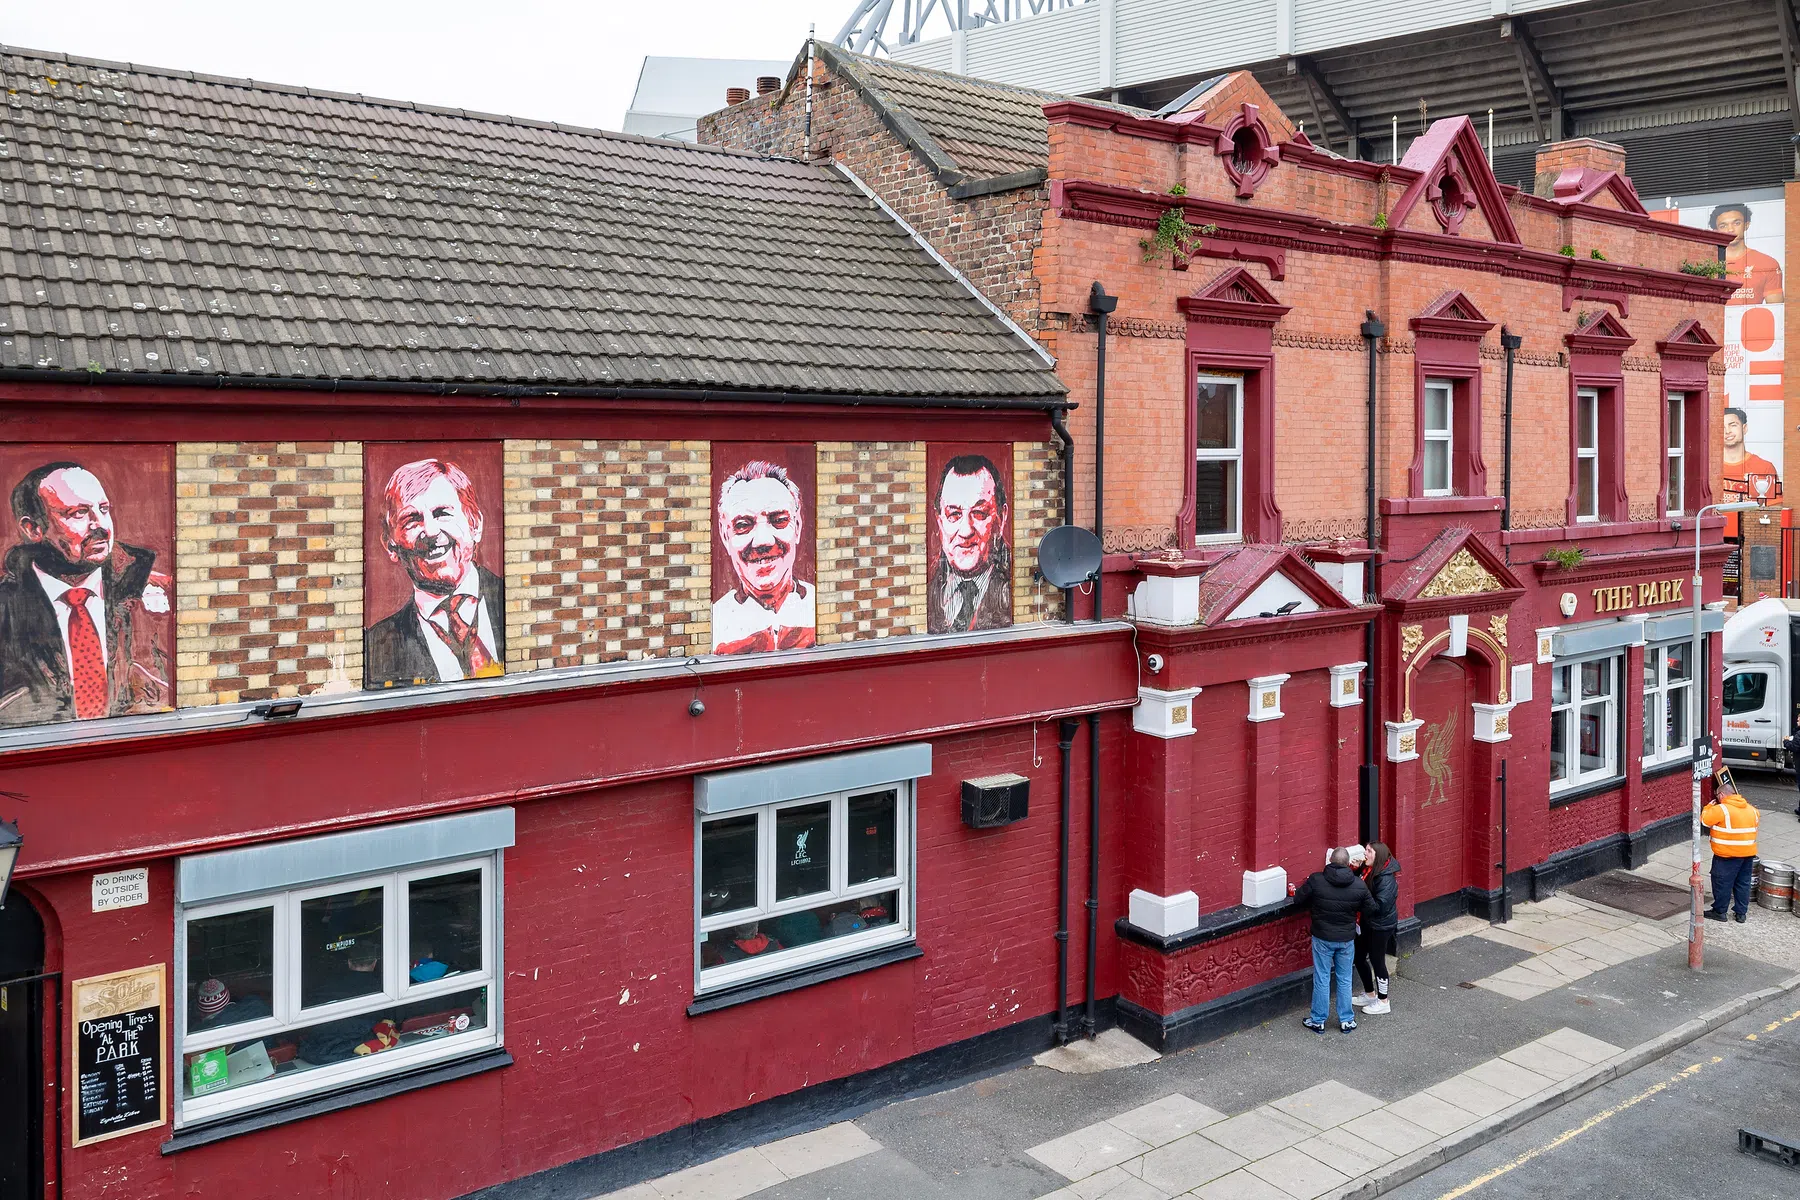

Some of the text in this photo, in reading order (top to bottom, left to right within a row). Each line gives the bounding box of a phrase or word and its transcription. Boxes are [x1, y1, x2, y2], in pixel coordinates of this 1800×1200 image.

[1592, 578, 1684, 613] THE PARK
[96, 872, 144, 887] NO DRINKS
[101, 883, 140, 896] OUTSIDE
[98, 892, 142, 906] BY ORDER
[82, 1020, 122, 1038] Opening
[96, 1041, 140, 1063] PARK
